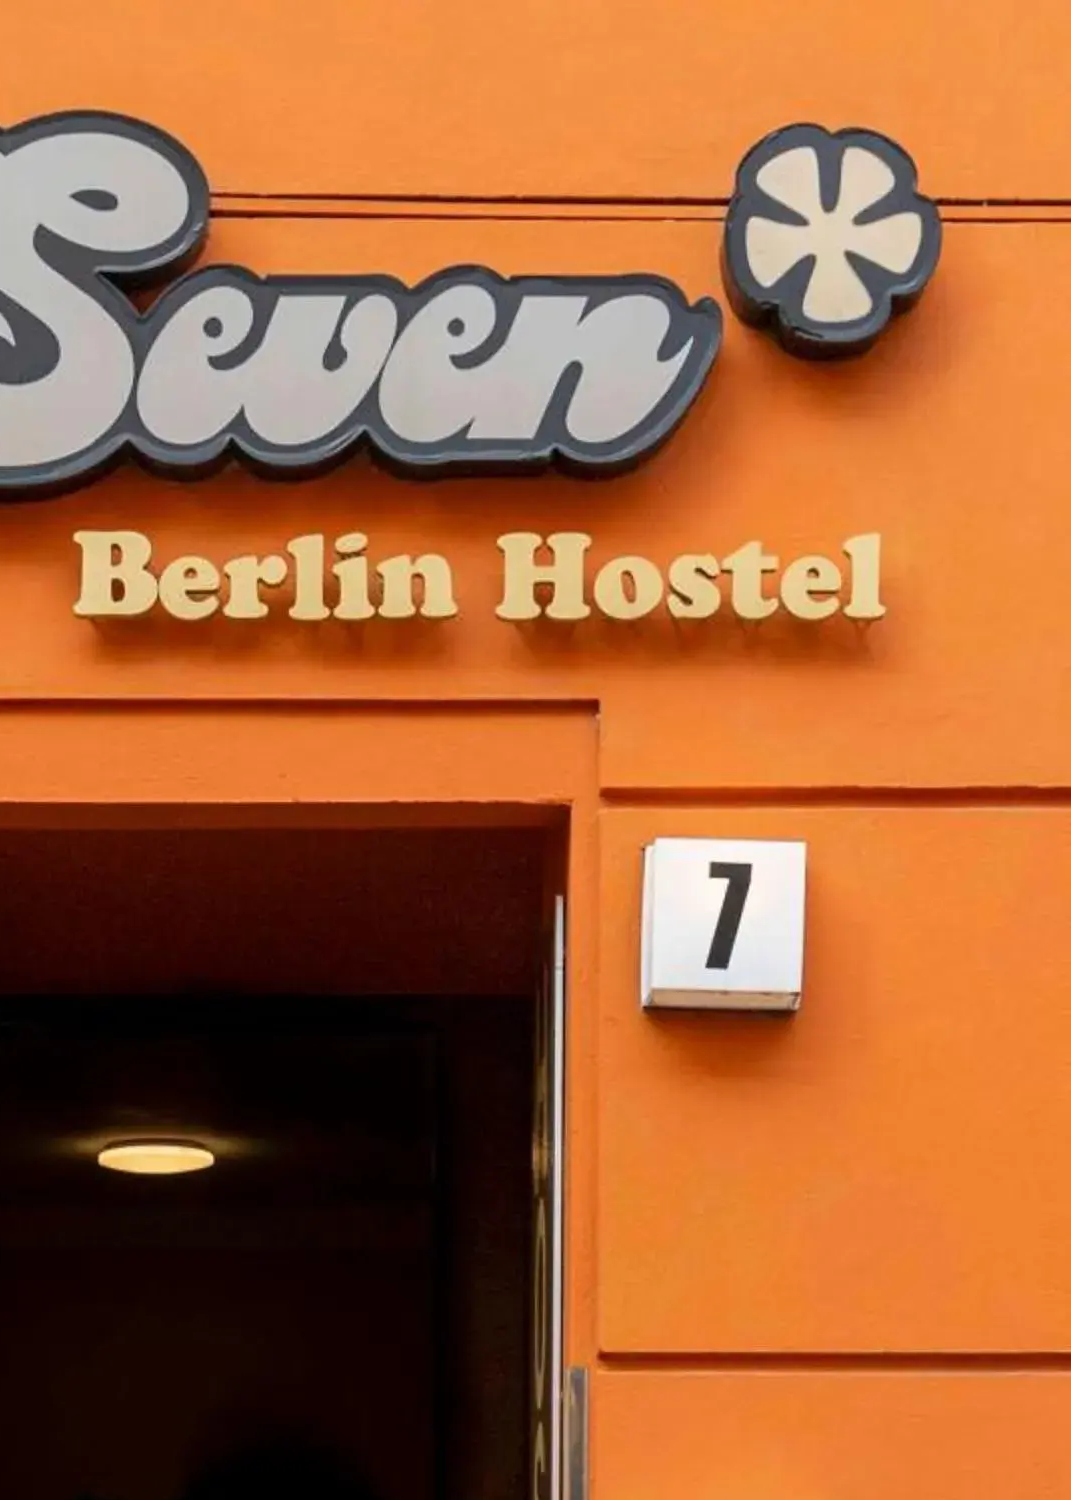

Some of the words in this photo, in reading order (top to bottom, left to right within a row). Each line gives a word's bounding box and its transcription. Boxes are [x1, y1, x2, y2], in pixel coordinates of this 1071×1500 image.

[73, 530, 458, 621] Berlin
[495, 531, 887, 622] Hostel
[705, 861, 753, 970] 7
